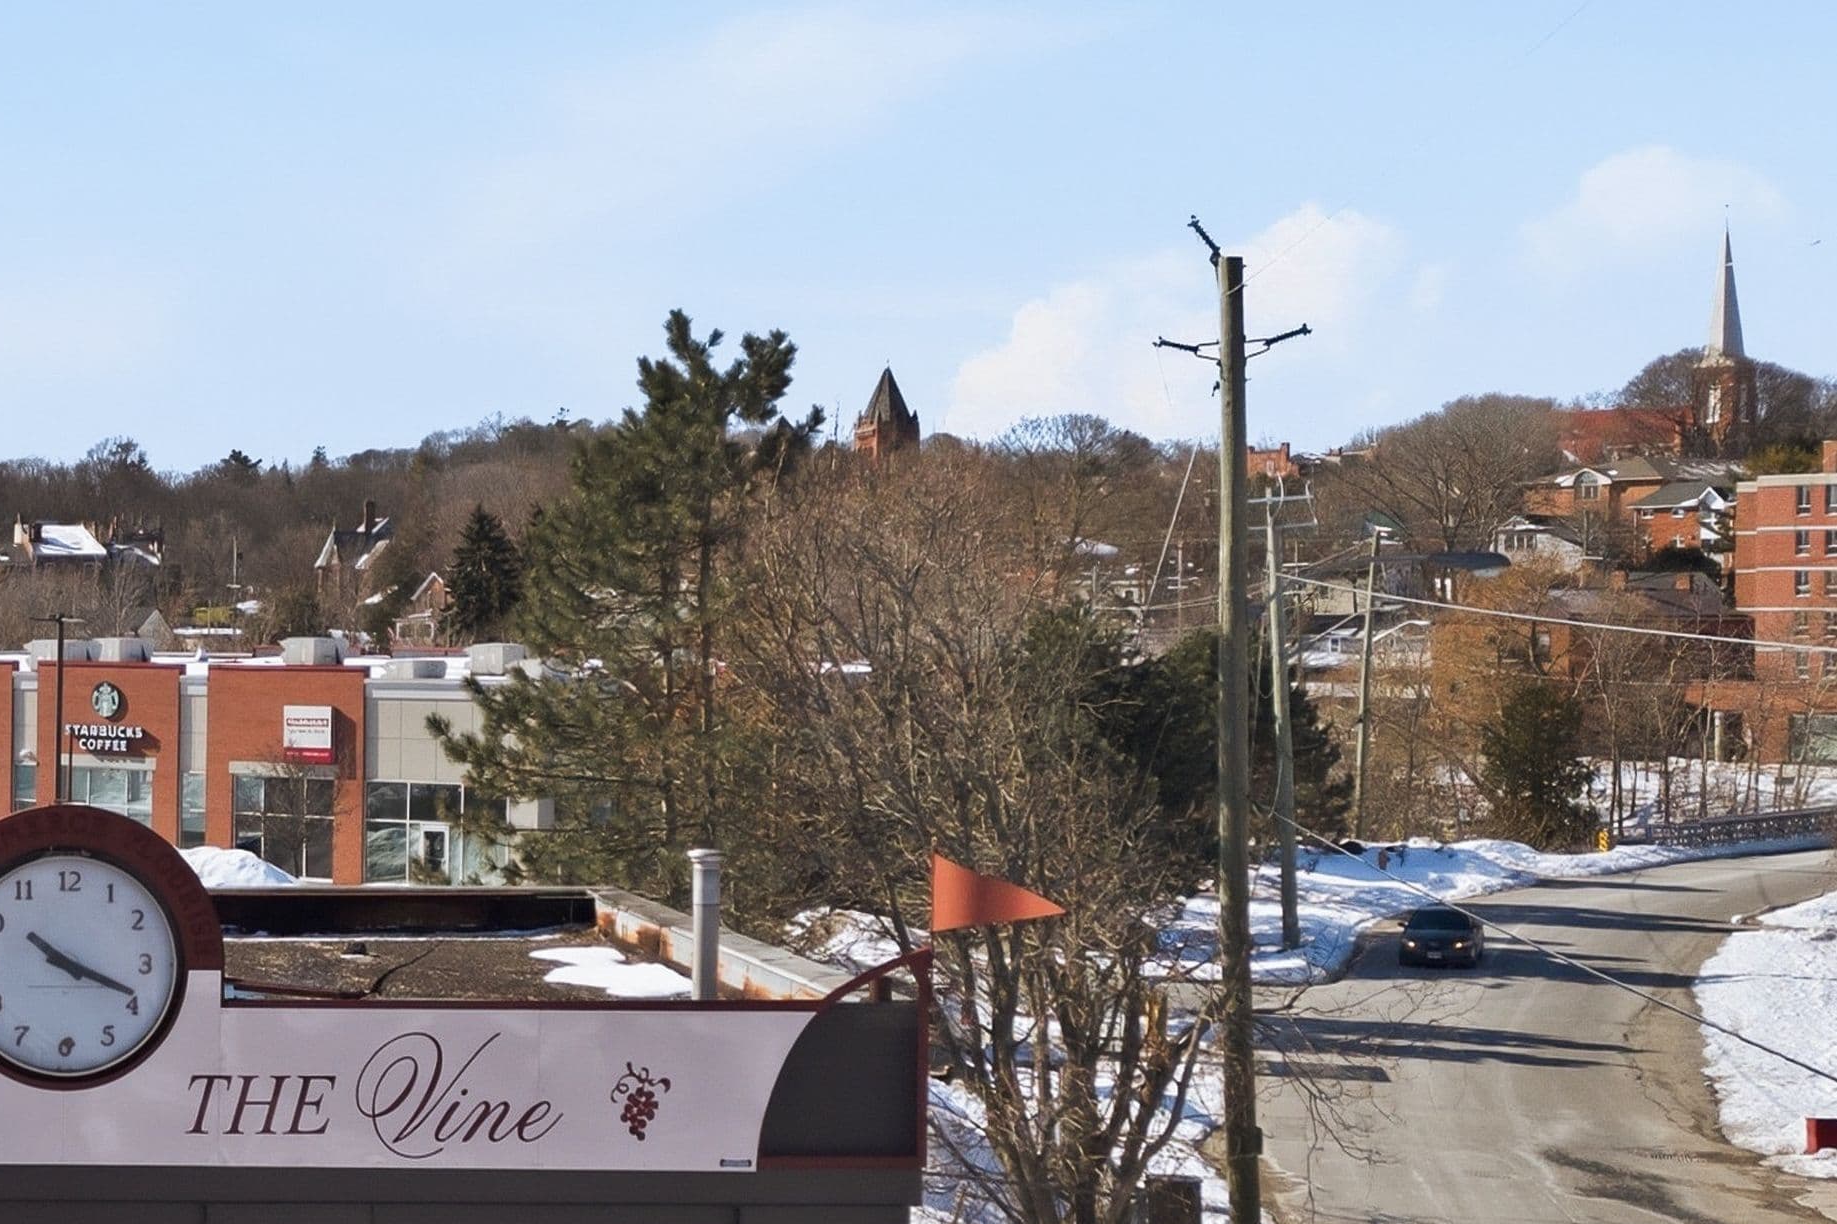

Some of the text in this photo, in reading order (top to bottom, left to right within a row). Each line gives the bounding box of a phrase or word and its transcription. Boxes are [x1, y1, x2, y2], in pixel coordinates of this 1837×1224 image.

[65, 724, 143, 738] STARBUCKS
[79, 738, 127, 751] COFFEE
[14, 880, 33, 900] 11
[58, 871, 81, 891] 12
[107, 883, 115, 903] 1
[131, 910, 145, 931] 2
[138, 953, 152, 974] 3
[125, 995, 139, 1015] 4
[14, 1026, 30, 1046] 7
[100, 1025, 115, 1046] 5
[58, 1037, 76, 1057] 6
[185, 1074, 336, 1136] THE
[355, 1031, 564, 1160] Vine
